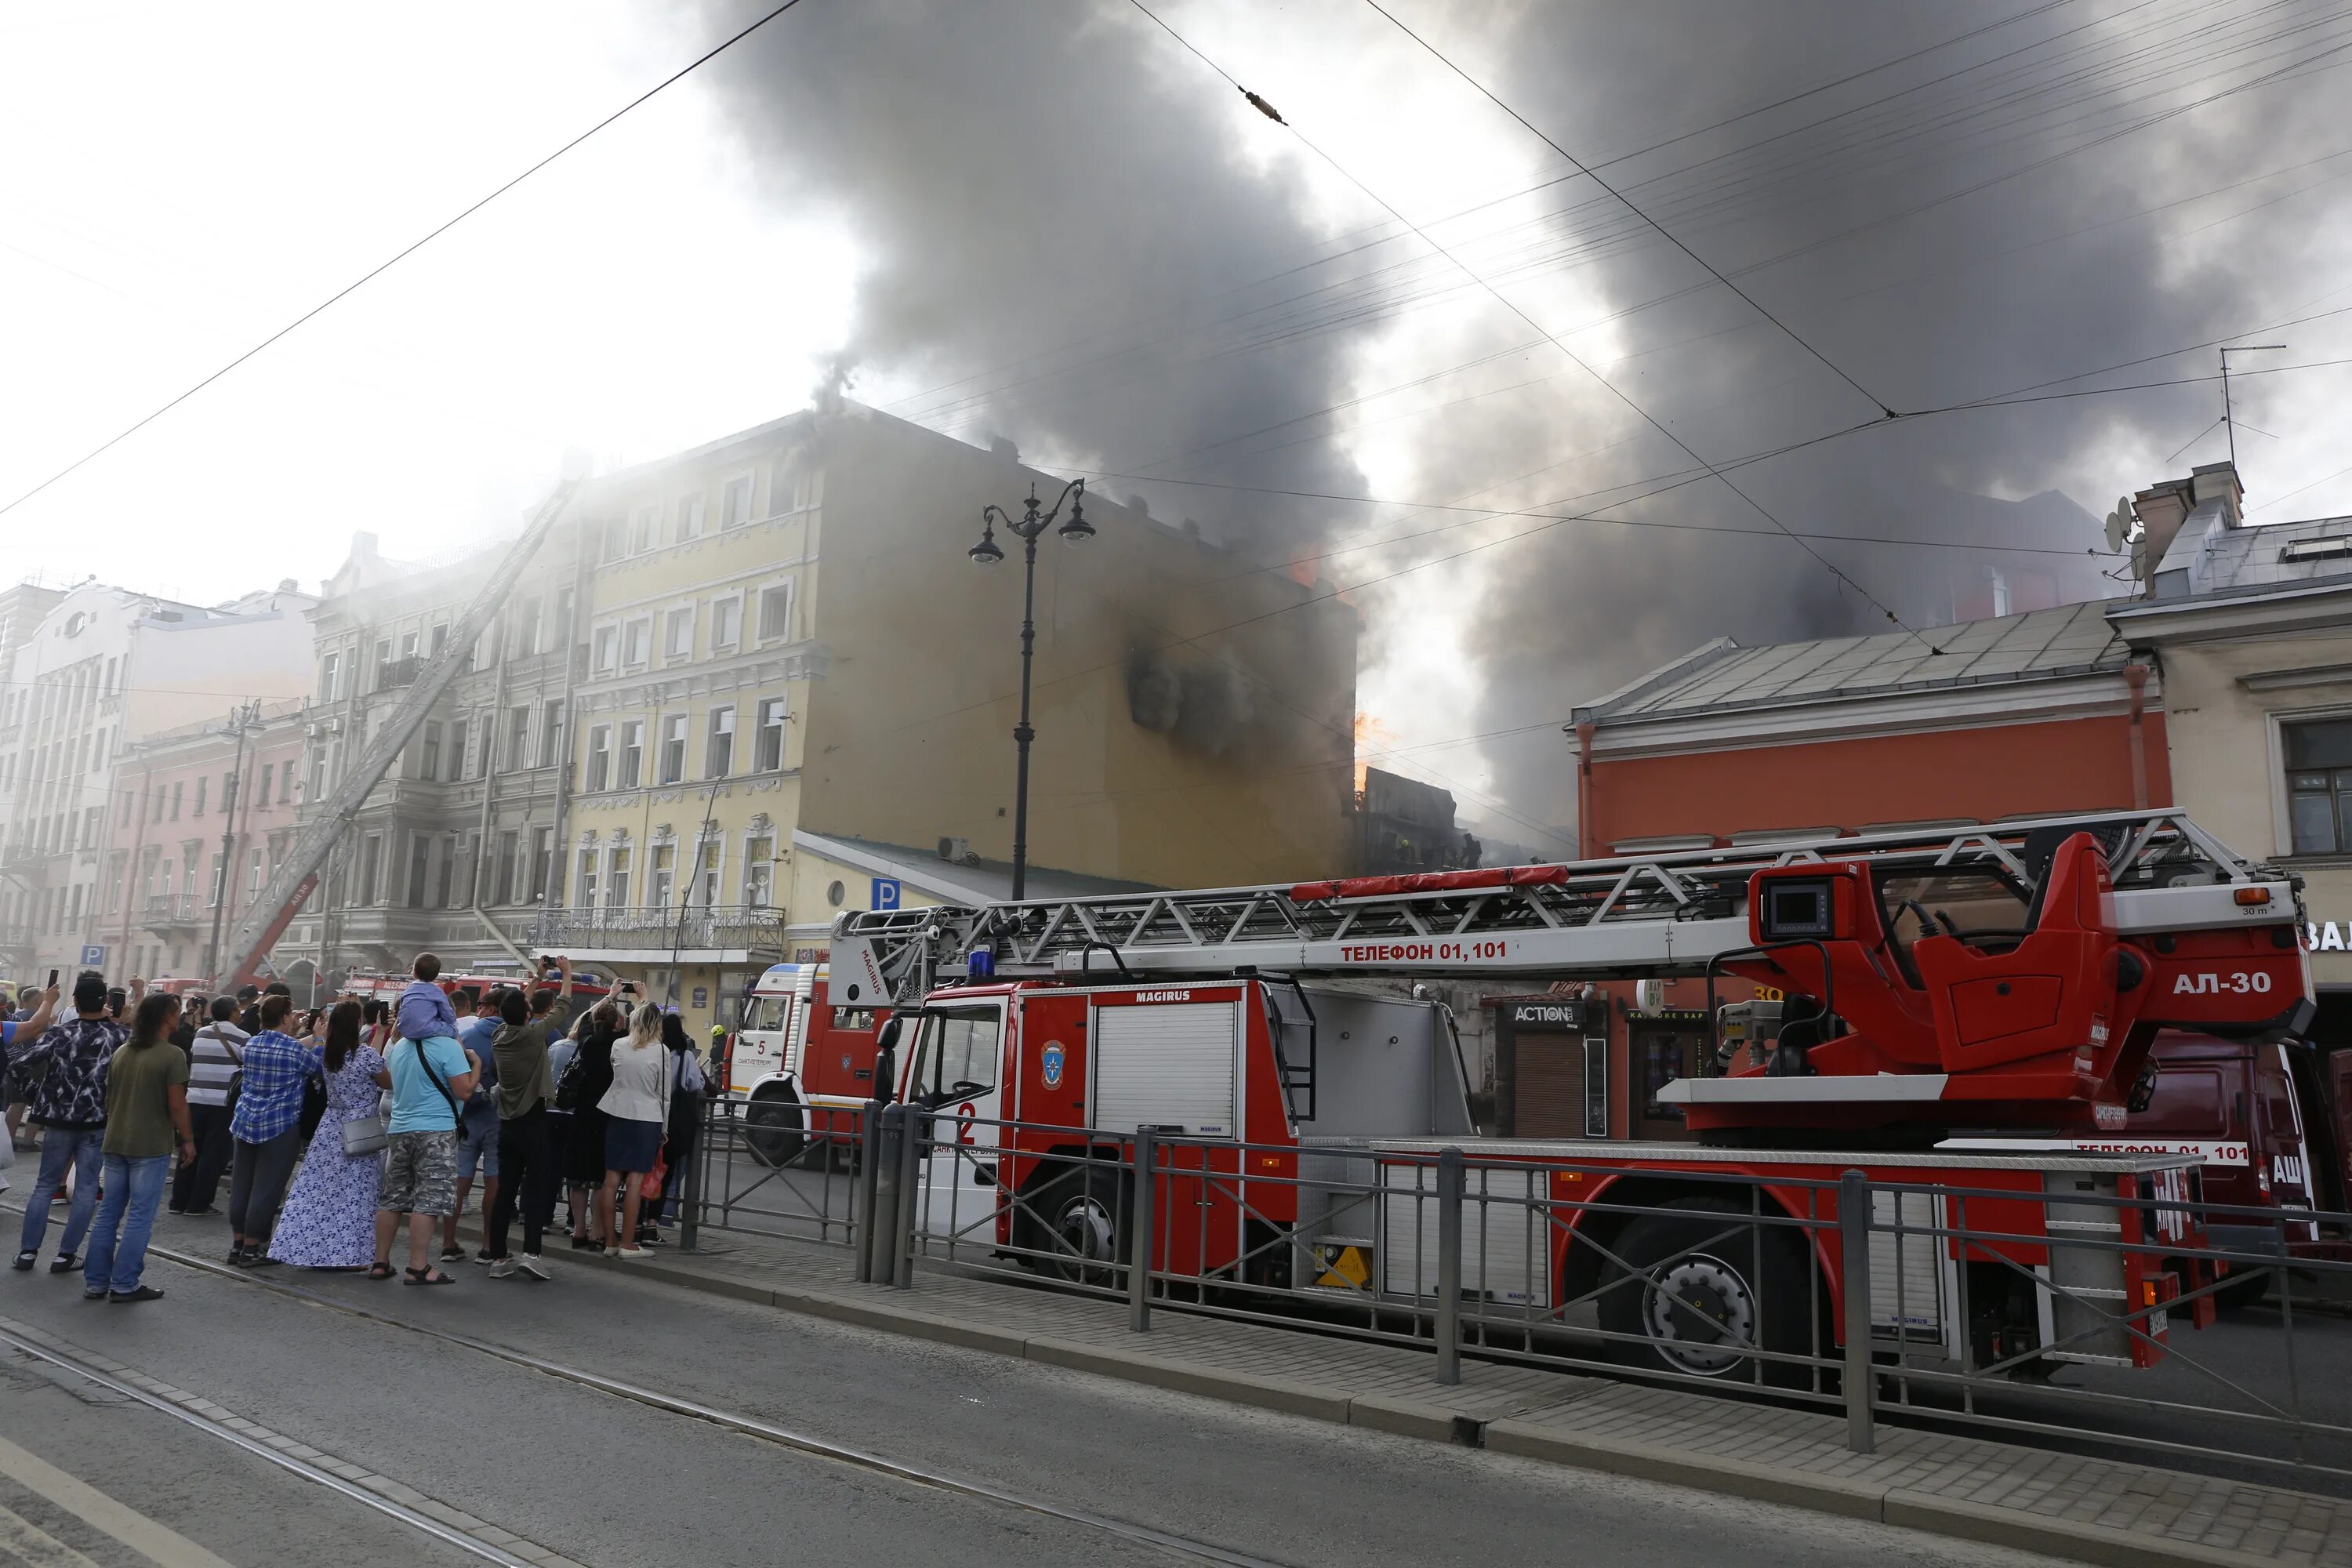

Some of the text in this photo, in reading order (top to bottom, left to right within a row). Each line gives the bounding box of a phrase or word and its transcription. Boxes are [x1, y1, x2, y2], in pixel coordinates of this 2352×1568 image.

[298, 884, 308, 895] 30
[880, 882, 895, 909] P
[88, 947, 100, 963] P
[1341, 941, 1506, 963] ТЕЛЕФОН 01, 101
[862, 949, 881, 995] MAGIRUS
[2173, 971, 2271, 994] АЛ-30
[1136, 990, 1190, 1003] MAGIRUS
[1515, 1007, 1568, 1021] ACTION
[757, 1040, 766, 1055] 5
[957, 1102, 976, 1145] 2
[2214, 1146, 2249, 1160] 101
[2274, 1155, 2302, 1184] АШ
